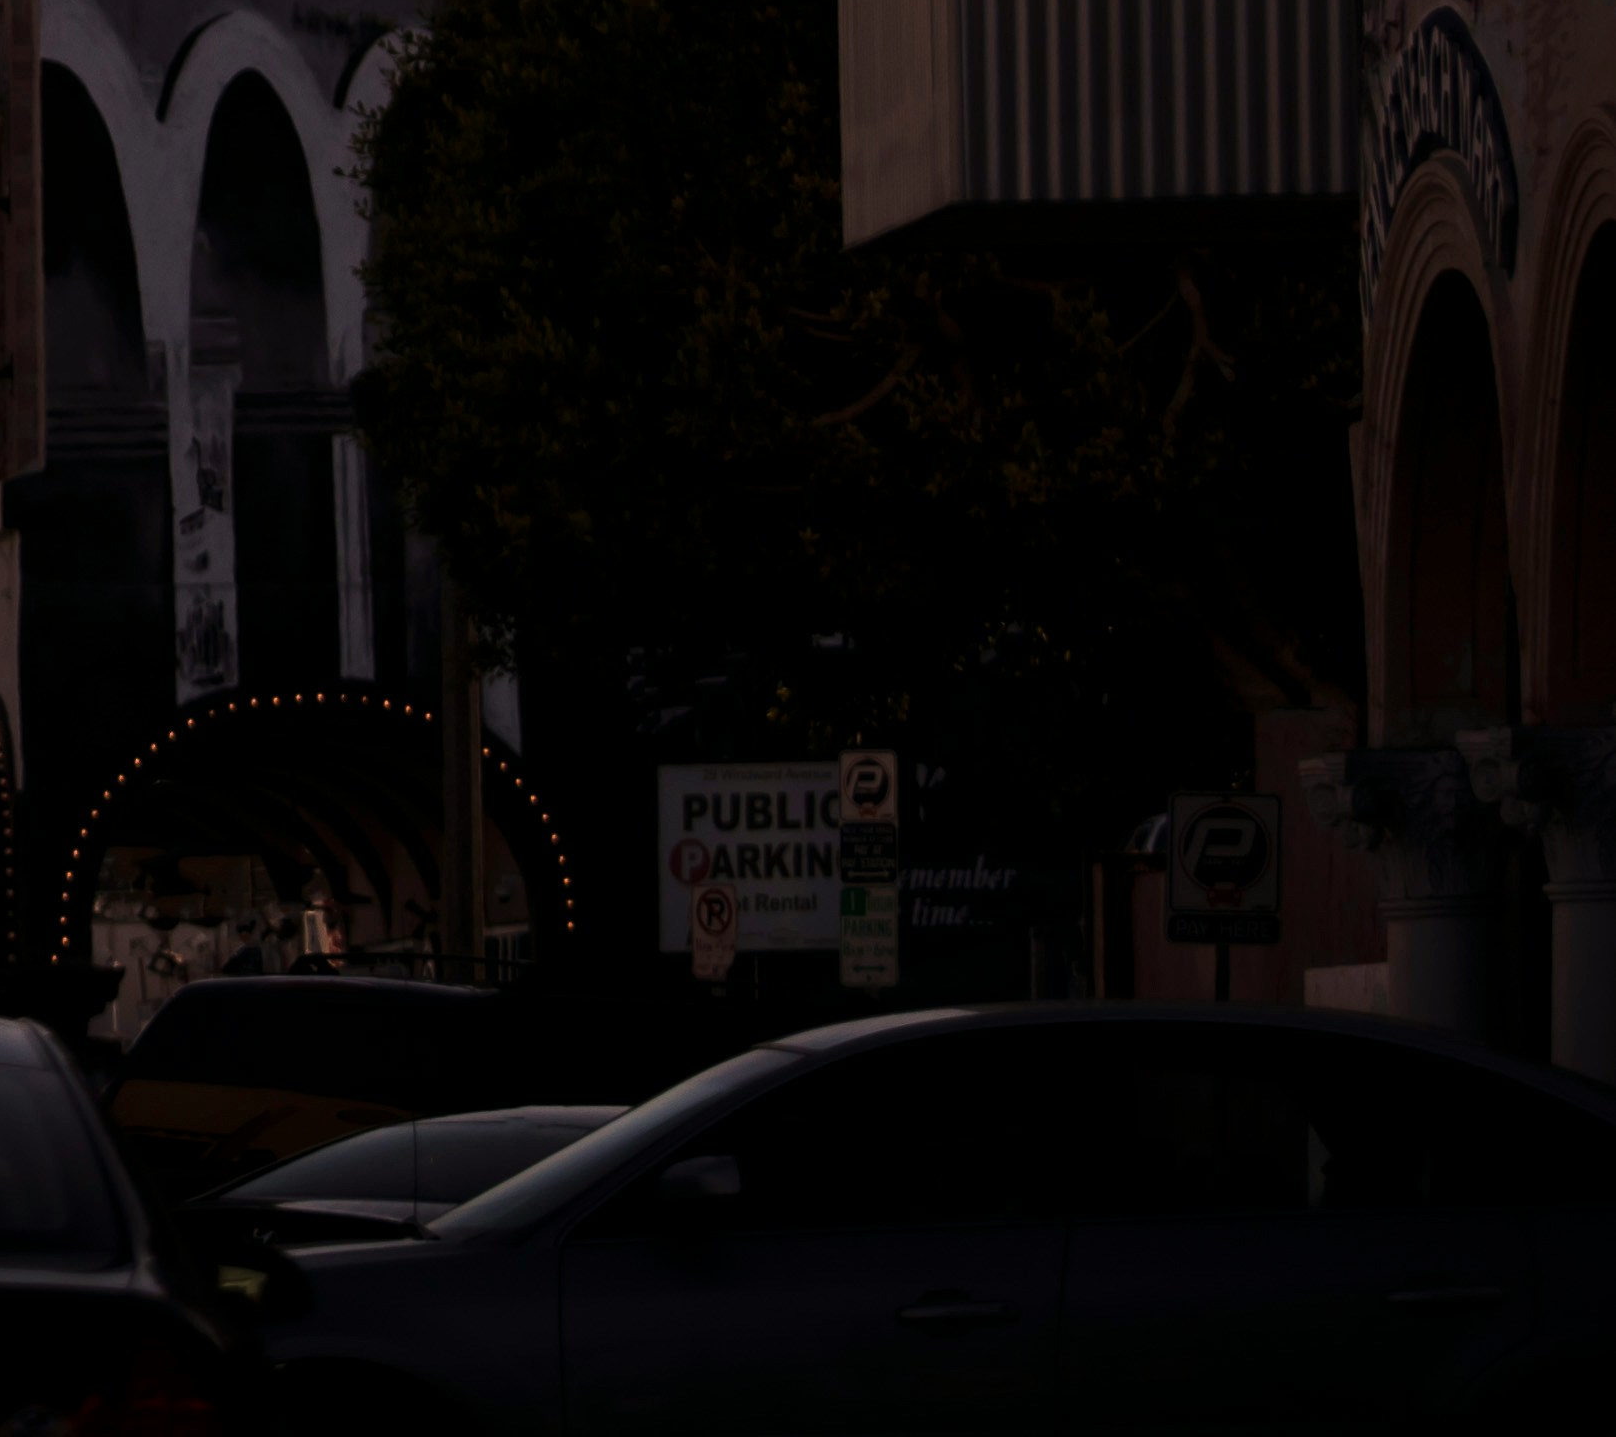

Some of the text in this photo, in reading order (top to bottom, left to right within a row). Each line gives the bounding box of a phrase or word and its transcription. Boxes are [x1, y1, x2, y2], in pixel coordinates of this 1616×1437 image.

[670, 840, 842, 883] PARKIN
[897, 854, 1018, 891] emember
[755, 893, 818, 912] Rental
[1175, 919, 1273, 939] PAY HERE
